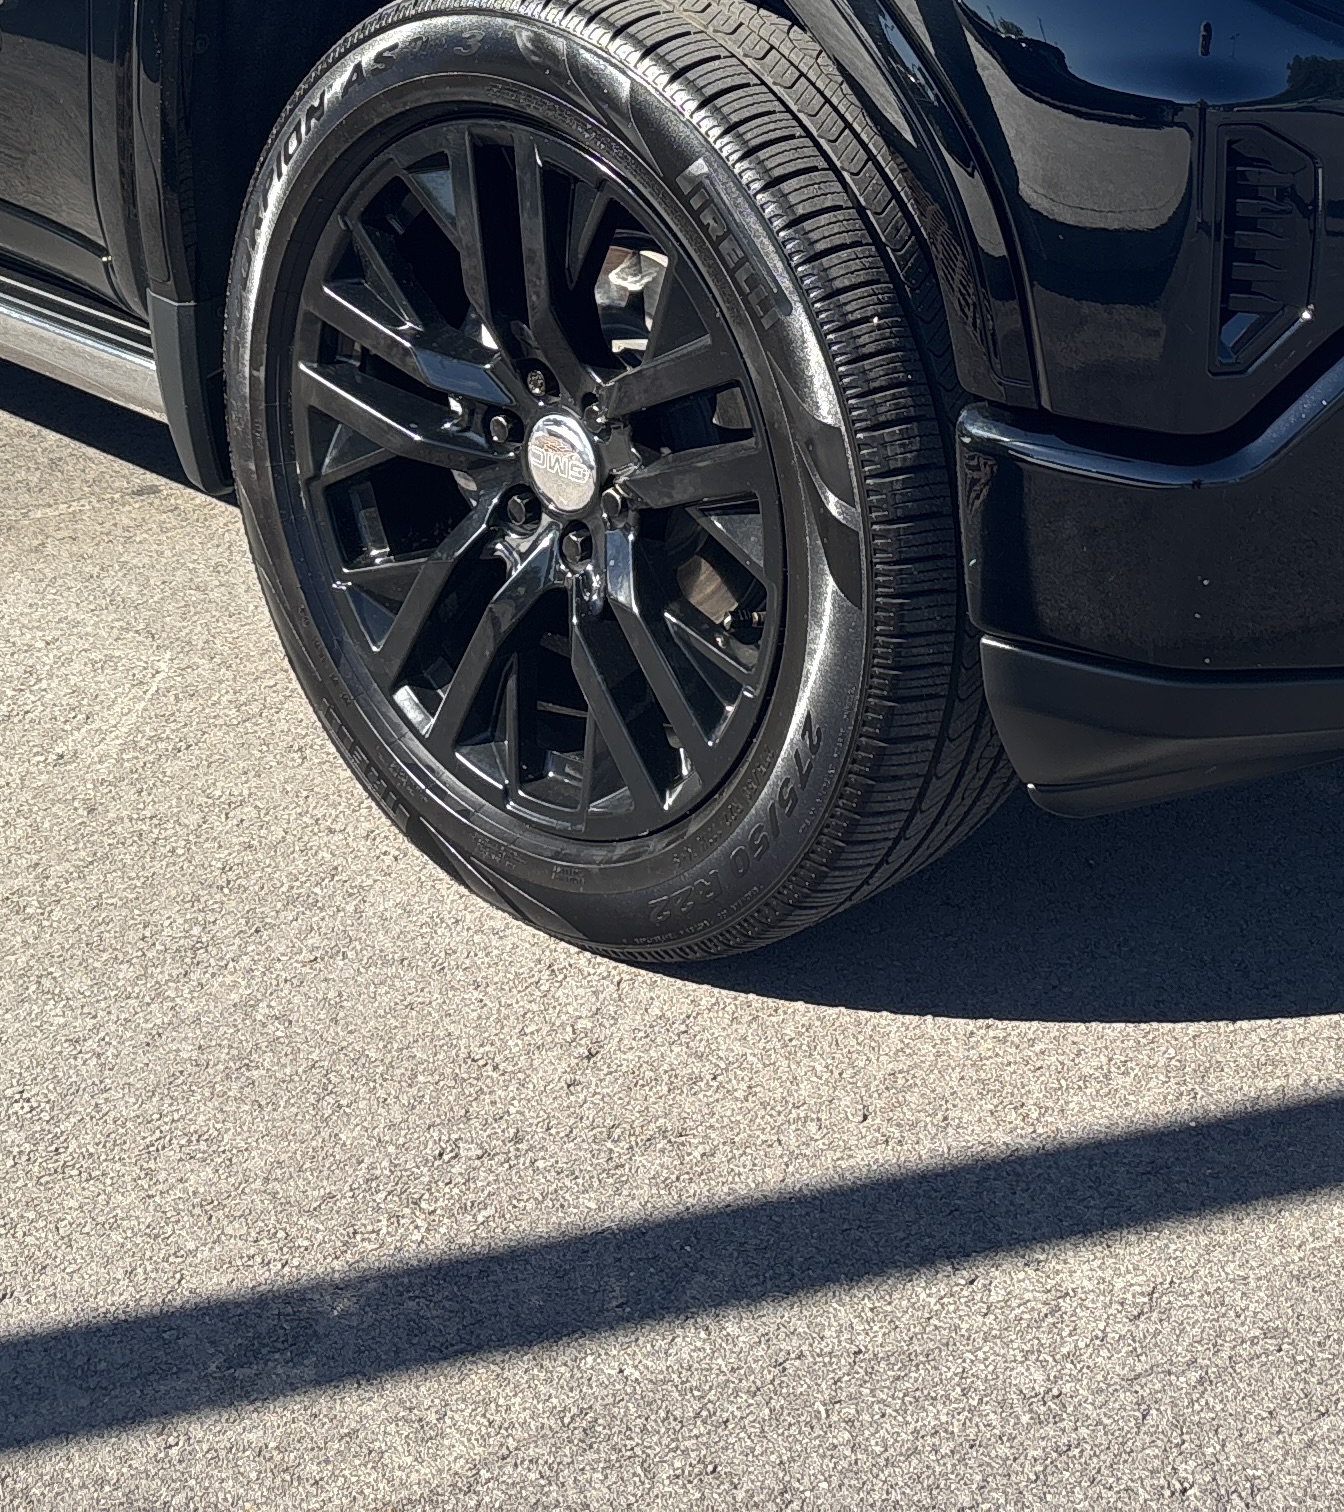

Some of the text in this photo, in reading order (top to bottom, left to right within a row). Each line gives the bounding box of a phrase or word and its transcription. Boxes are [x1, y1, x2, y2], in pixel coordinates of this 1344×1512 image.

[676, 156, 790, 332] PIRELLI
[529, 444, 591, 484] GMC
[729, 710, 823, 879] 275/50
[649, 868, 724, 922] R22
